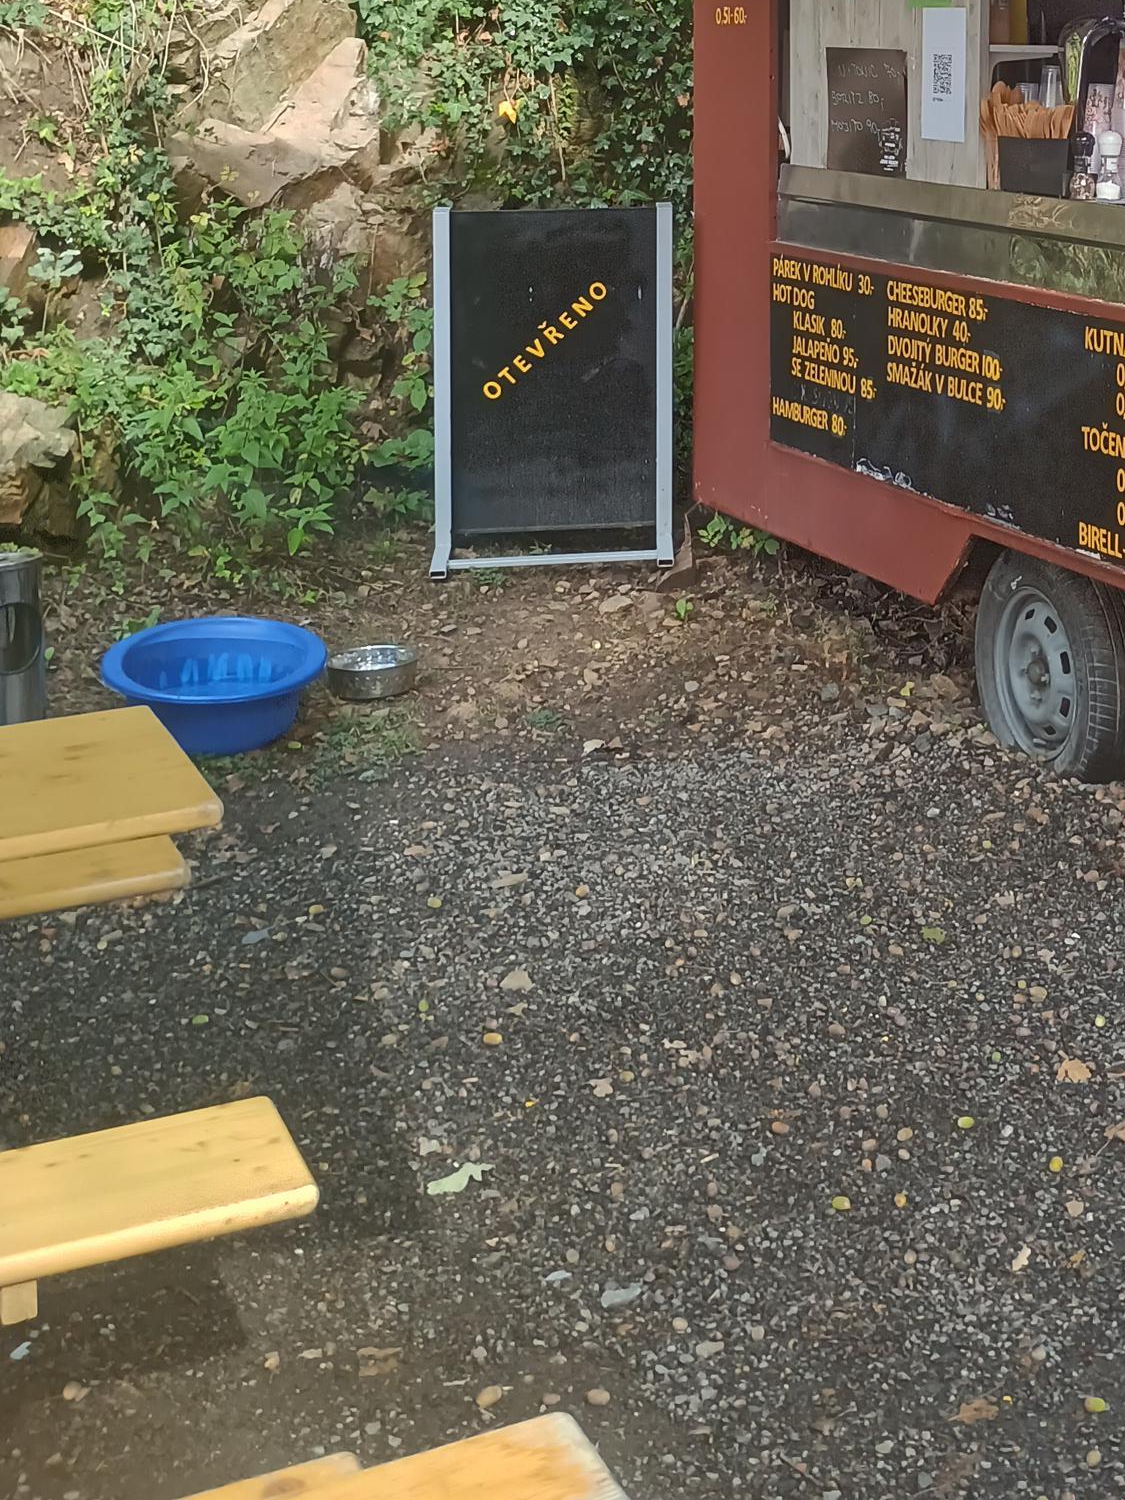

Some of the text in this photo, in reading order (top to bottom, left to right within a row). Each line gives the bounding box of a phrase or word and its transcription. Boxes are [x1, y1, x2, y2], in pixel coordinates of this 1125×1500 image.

[773, 254, 801, 280] PÁREK
[803, 263, 811, 282] V
[812, 263, 853, 291] ROHLÍKU
[773, 283, 815, 310] HOT DOG
[887, 280, 966, 317] CHEESEBURGER
[482, 281, 607, 400] OTEVŘENO
[793, 310, 825, 336] KLASIK
[887, 306, 948, 338] HRANOLKY
[887, 337, 931, 363] DVOJITÝ
[935, 344, 979, 374] BURGER
[791, 356, 802, 378] SE
[804, 362, 856, 394] ZELENINOU
[887, 361, 932, 393] SMAŽÁK
[935, 373, 945, 394] V
[947, 375, 983, 405] BULCE
[772, 397, 829, 431] HAMBURGER
